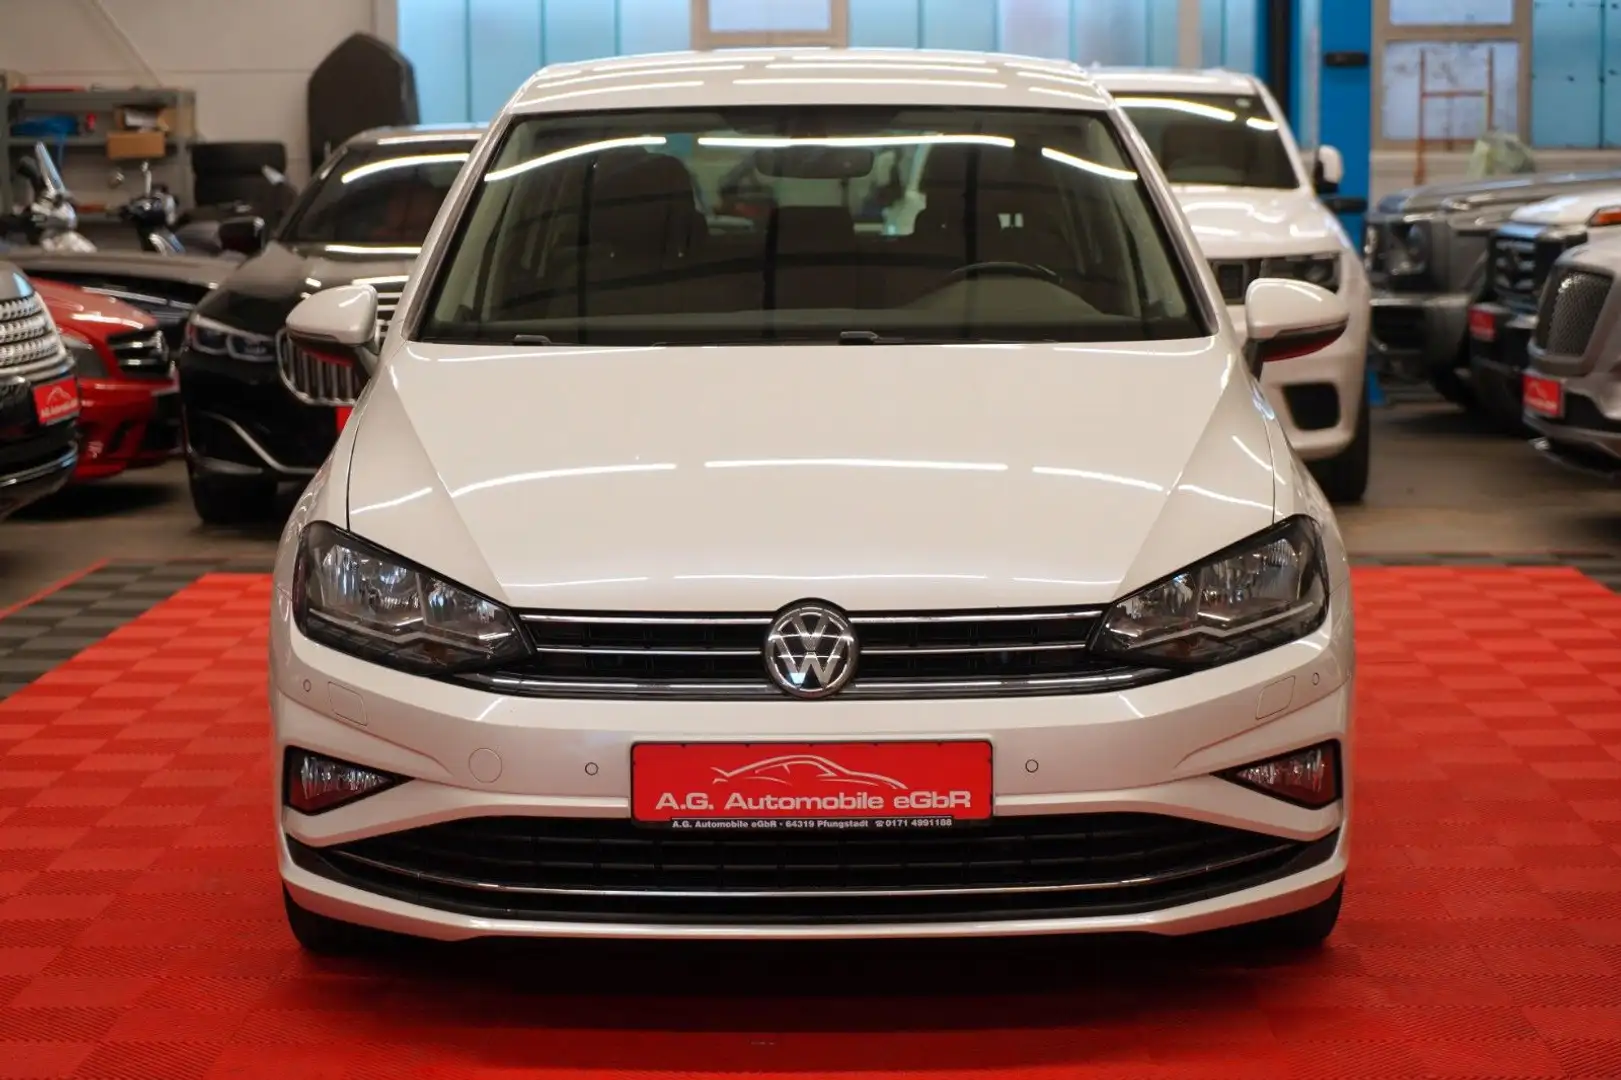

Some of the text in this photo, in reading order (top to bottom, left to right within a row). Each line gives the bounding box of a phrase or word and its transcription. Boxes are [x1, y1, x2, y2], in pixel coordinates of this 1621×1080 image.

[767, 606, 853, 696] VW
[655, 790, 971, 810] A.G. Automobile eGbR
[672, 820, 692, 828] A.G.
[695, 820, 749, 828] Automobile
[751, 820, 777, 828] eGbR
[785, 820, 815, 828] 64319
[817, 819, 869, 829] Pfungstadt
[885, 818, 908, 827] 0171
